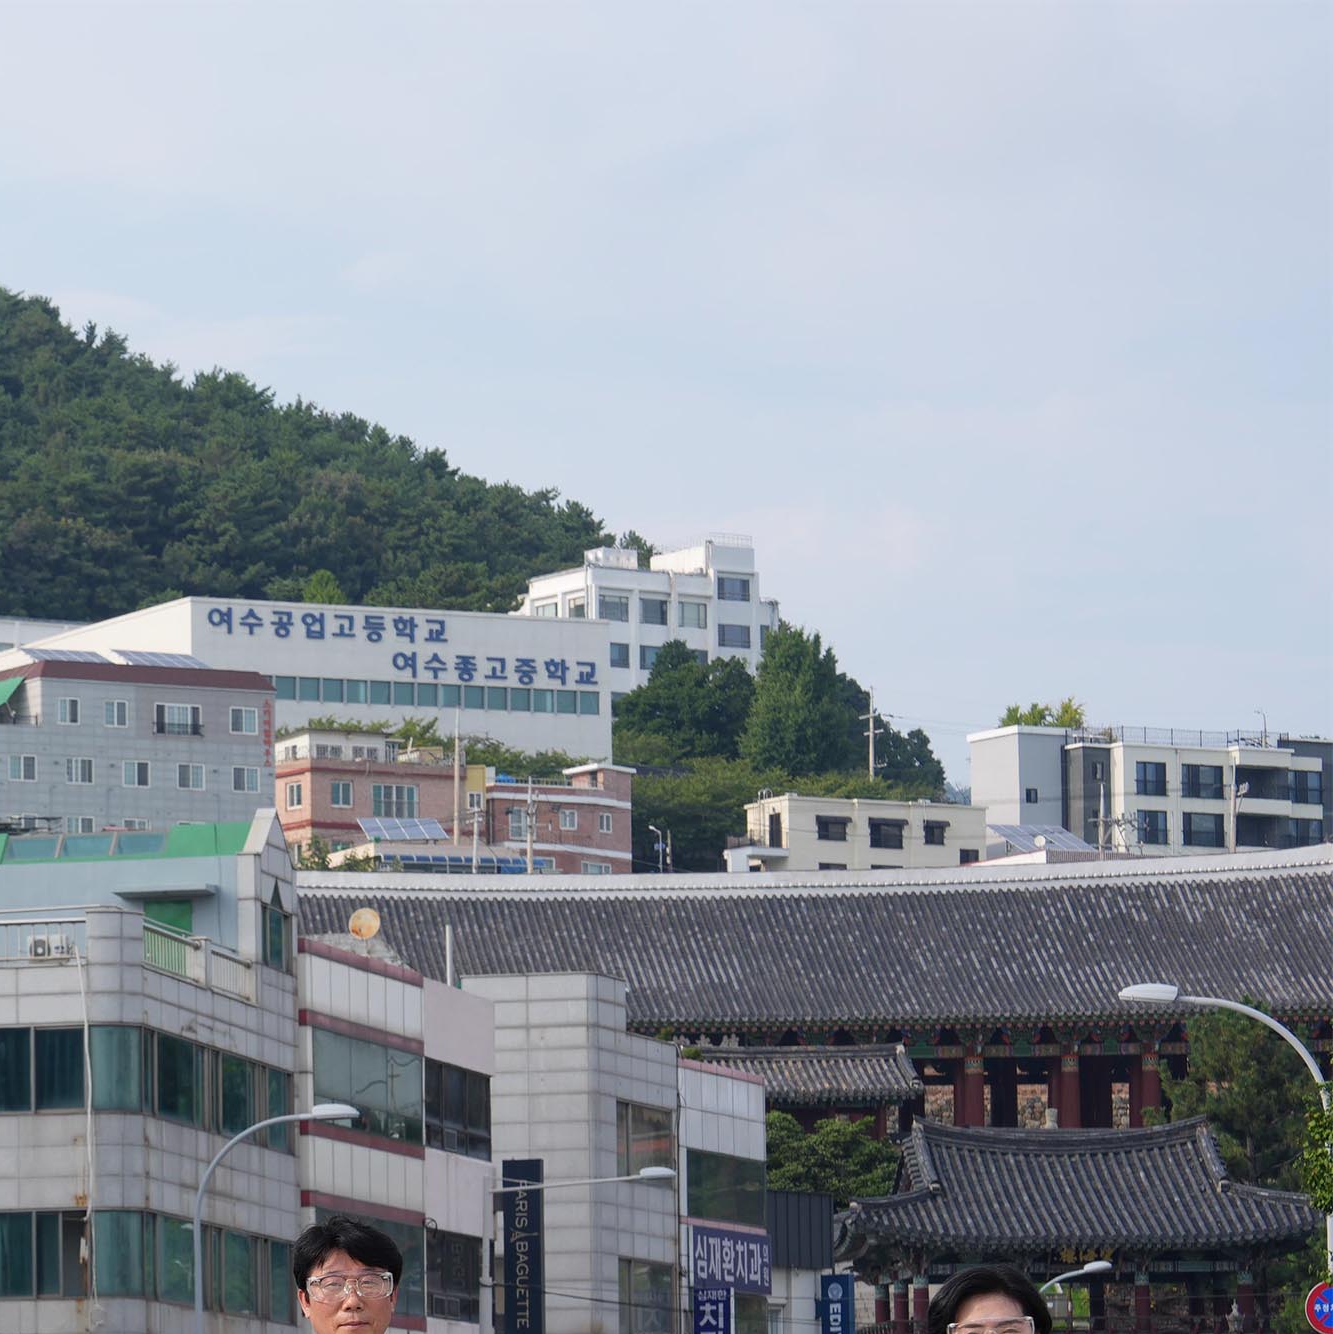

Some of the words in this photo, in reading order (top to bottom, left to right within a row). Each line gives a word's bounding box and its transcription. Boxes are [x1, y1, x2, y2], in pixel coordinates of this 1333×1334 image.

[208, 606, 449, 644] 여수공업고등학교
[391, 651, 599, 687] 여수종고중학교
[694, 1234, 763, 1287] 심재환치과
[515, 1240, 531, 1330] BAGUETTE
